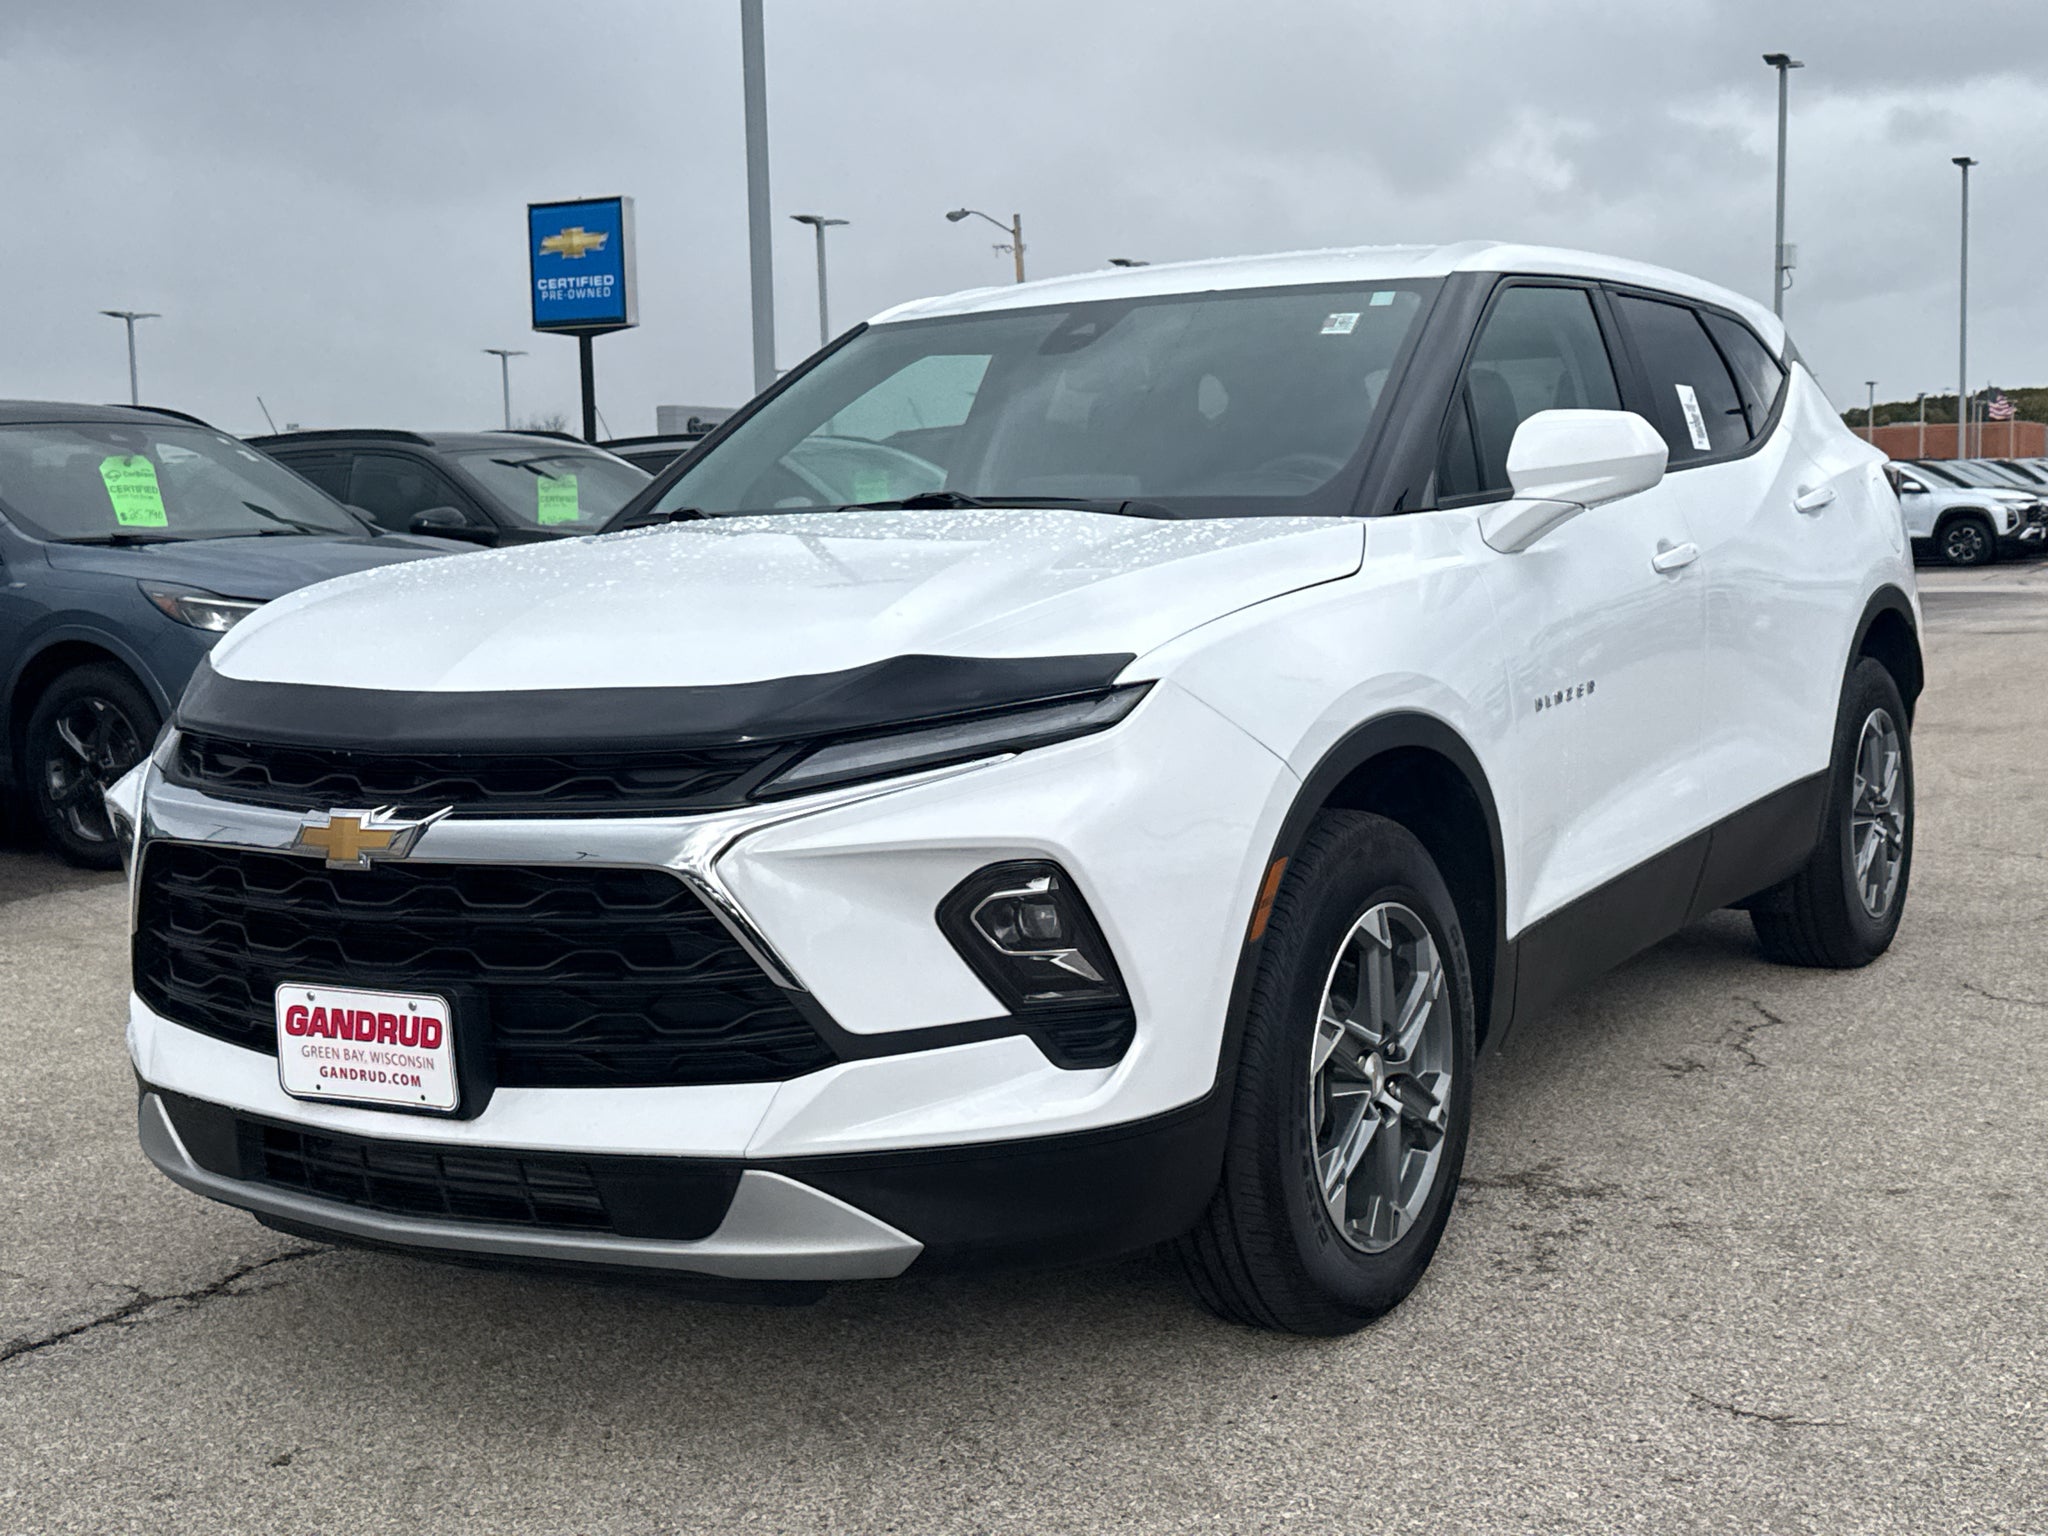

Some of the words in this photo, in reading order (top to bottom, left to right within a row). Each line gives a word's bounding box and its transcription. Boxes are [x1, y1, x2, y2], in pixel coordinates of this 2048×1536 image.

[537, 274, 614, 290] CERTIFIED
[541, 286, 612, 301] PRE-OWNED
[1535, 680, 1595, 712] BLAZER
[285, 1005, 443, 1049] GANDRUD
[301, 1044, 340, 1060] GREEN
[343, 1049, 368, 1063] BAY,
[371, 1053, 435, 1070] WISCONSIN
[320, 1066, 422, 1088] GANDRUD.COM
